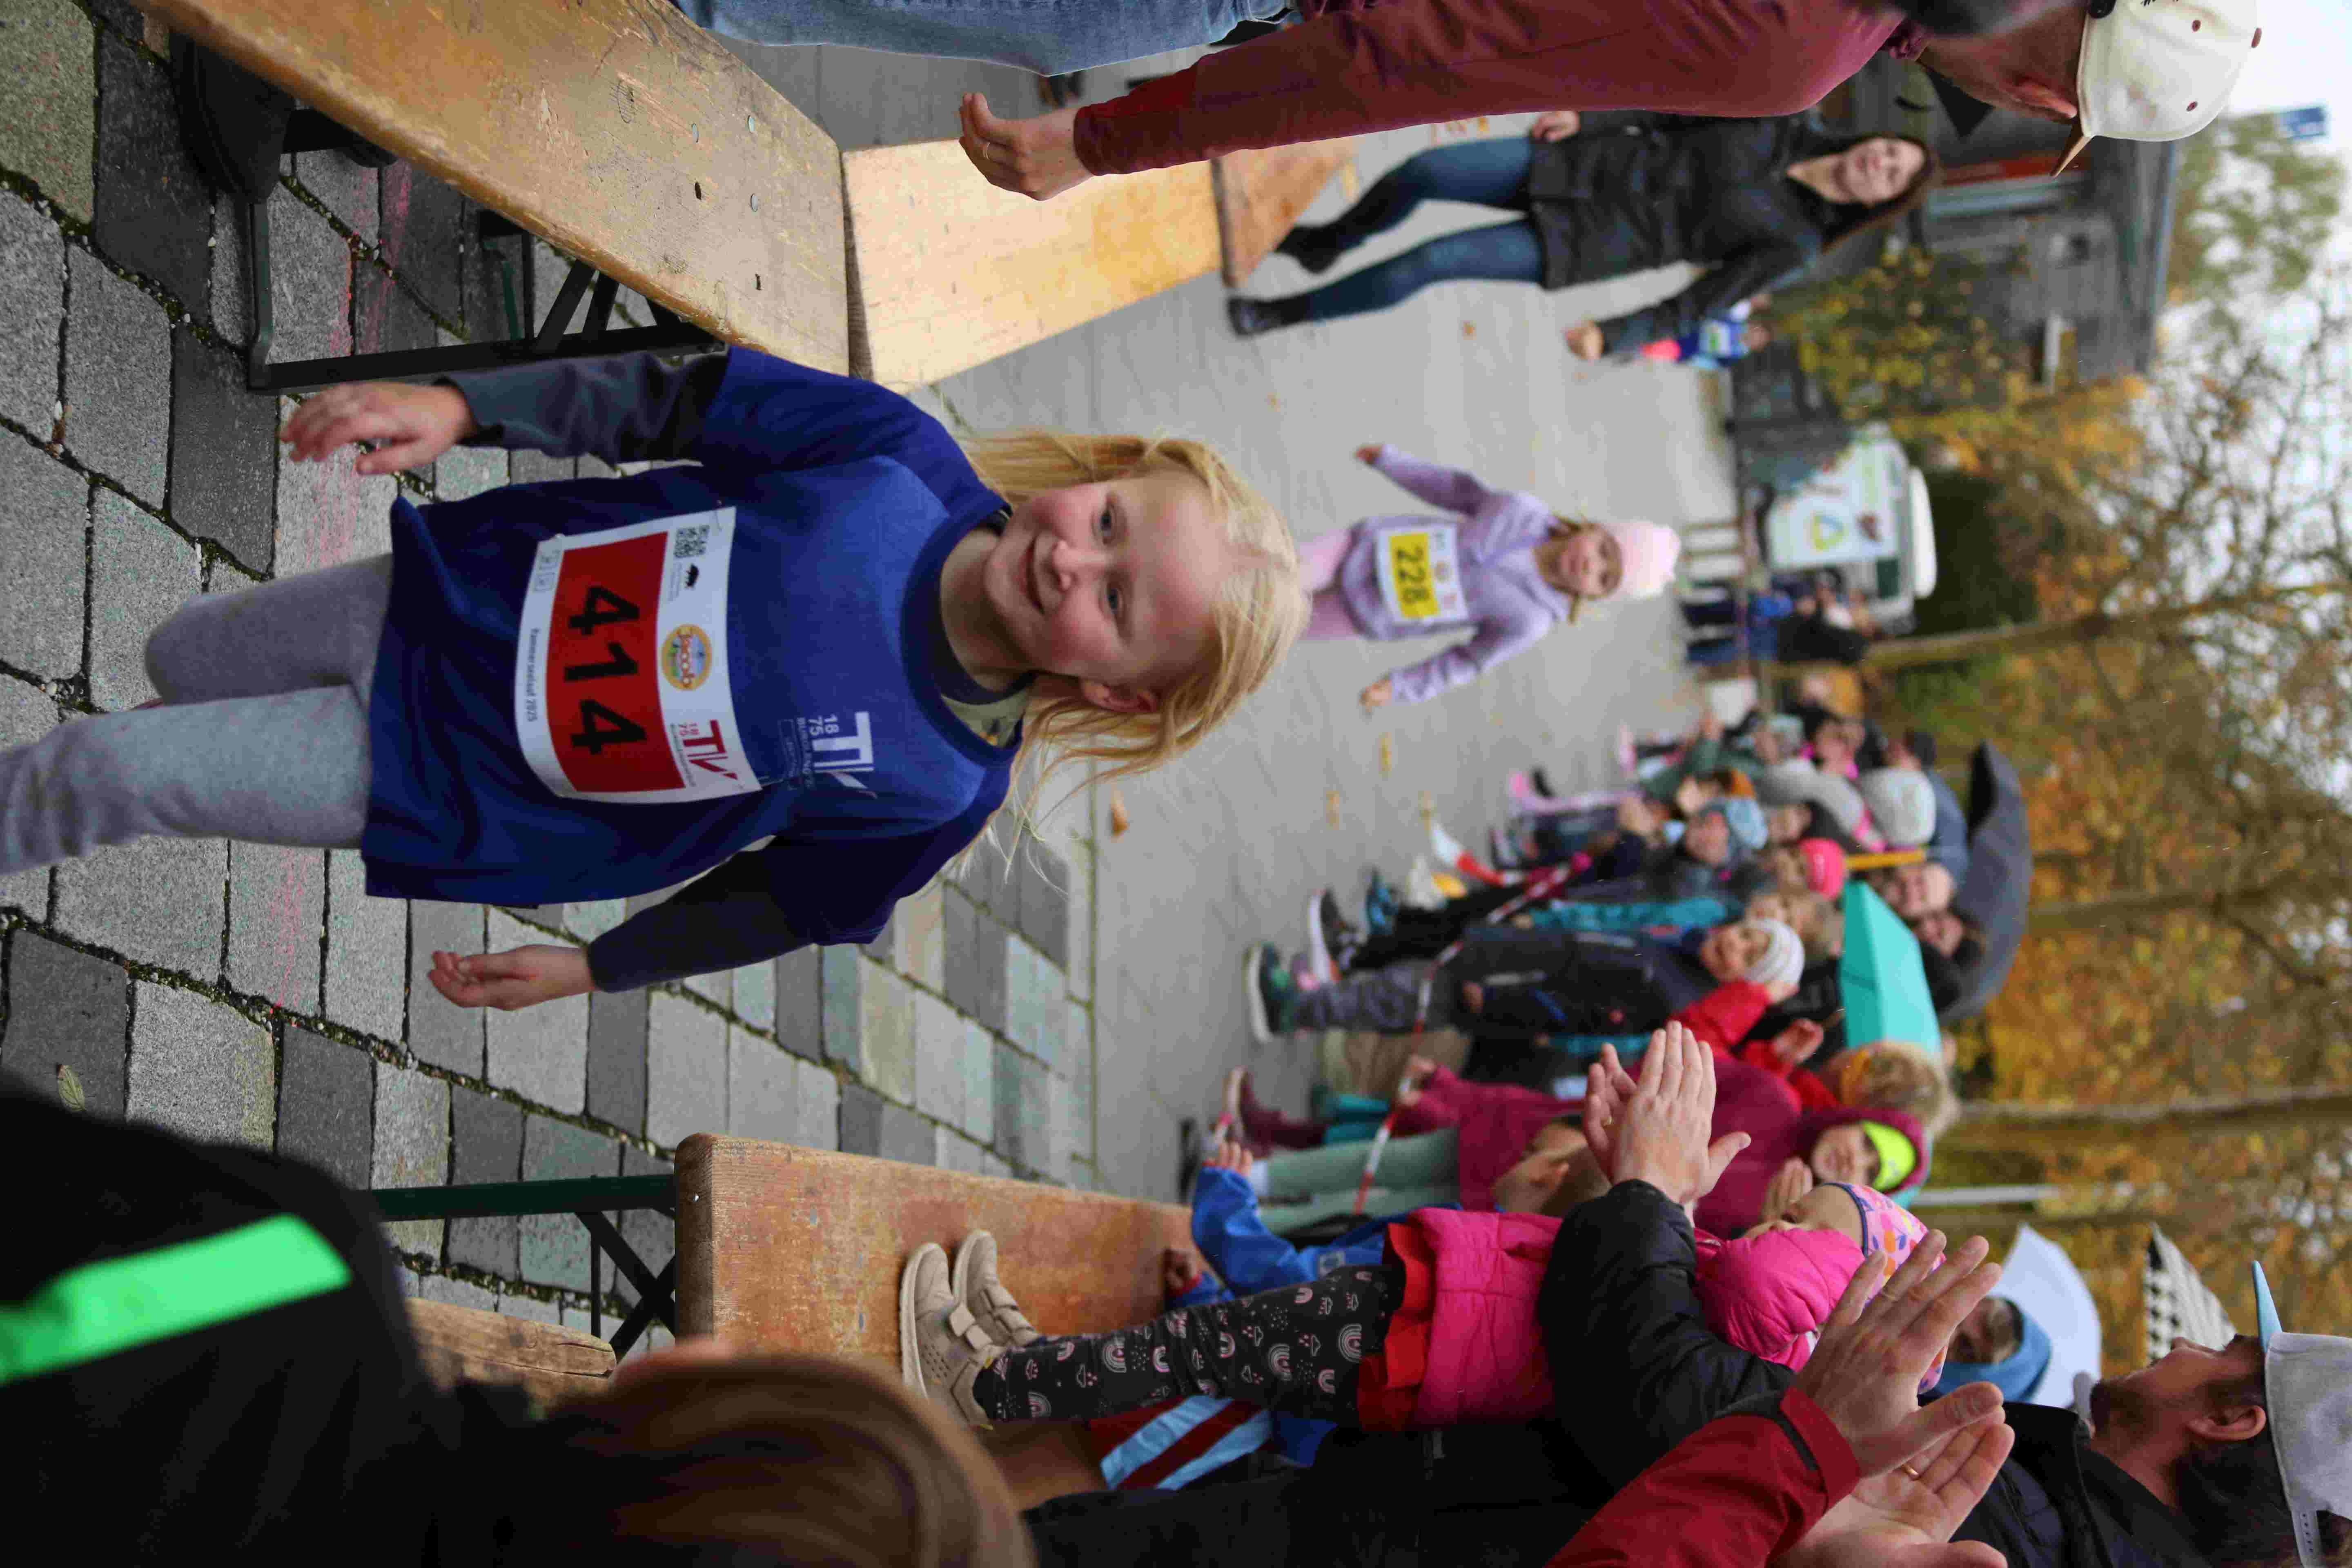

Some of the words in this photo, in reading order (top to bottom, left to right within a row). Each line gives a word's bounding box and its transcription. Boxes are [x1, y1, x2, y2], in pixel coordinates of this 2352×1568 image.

[1396, 546, 1431, 605] 228
[564, 586, 647, 755] 414
[683, 720, 738, 780] TV
[808, 716, 824, 736] 75
[824, 714, 840, 734] 18
